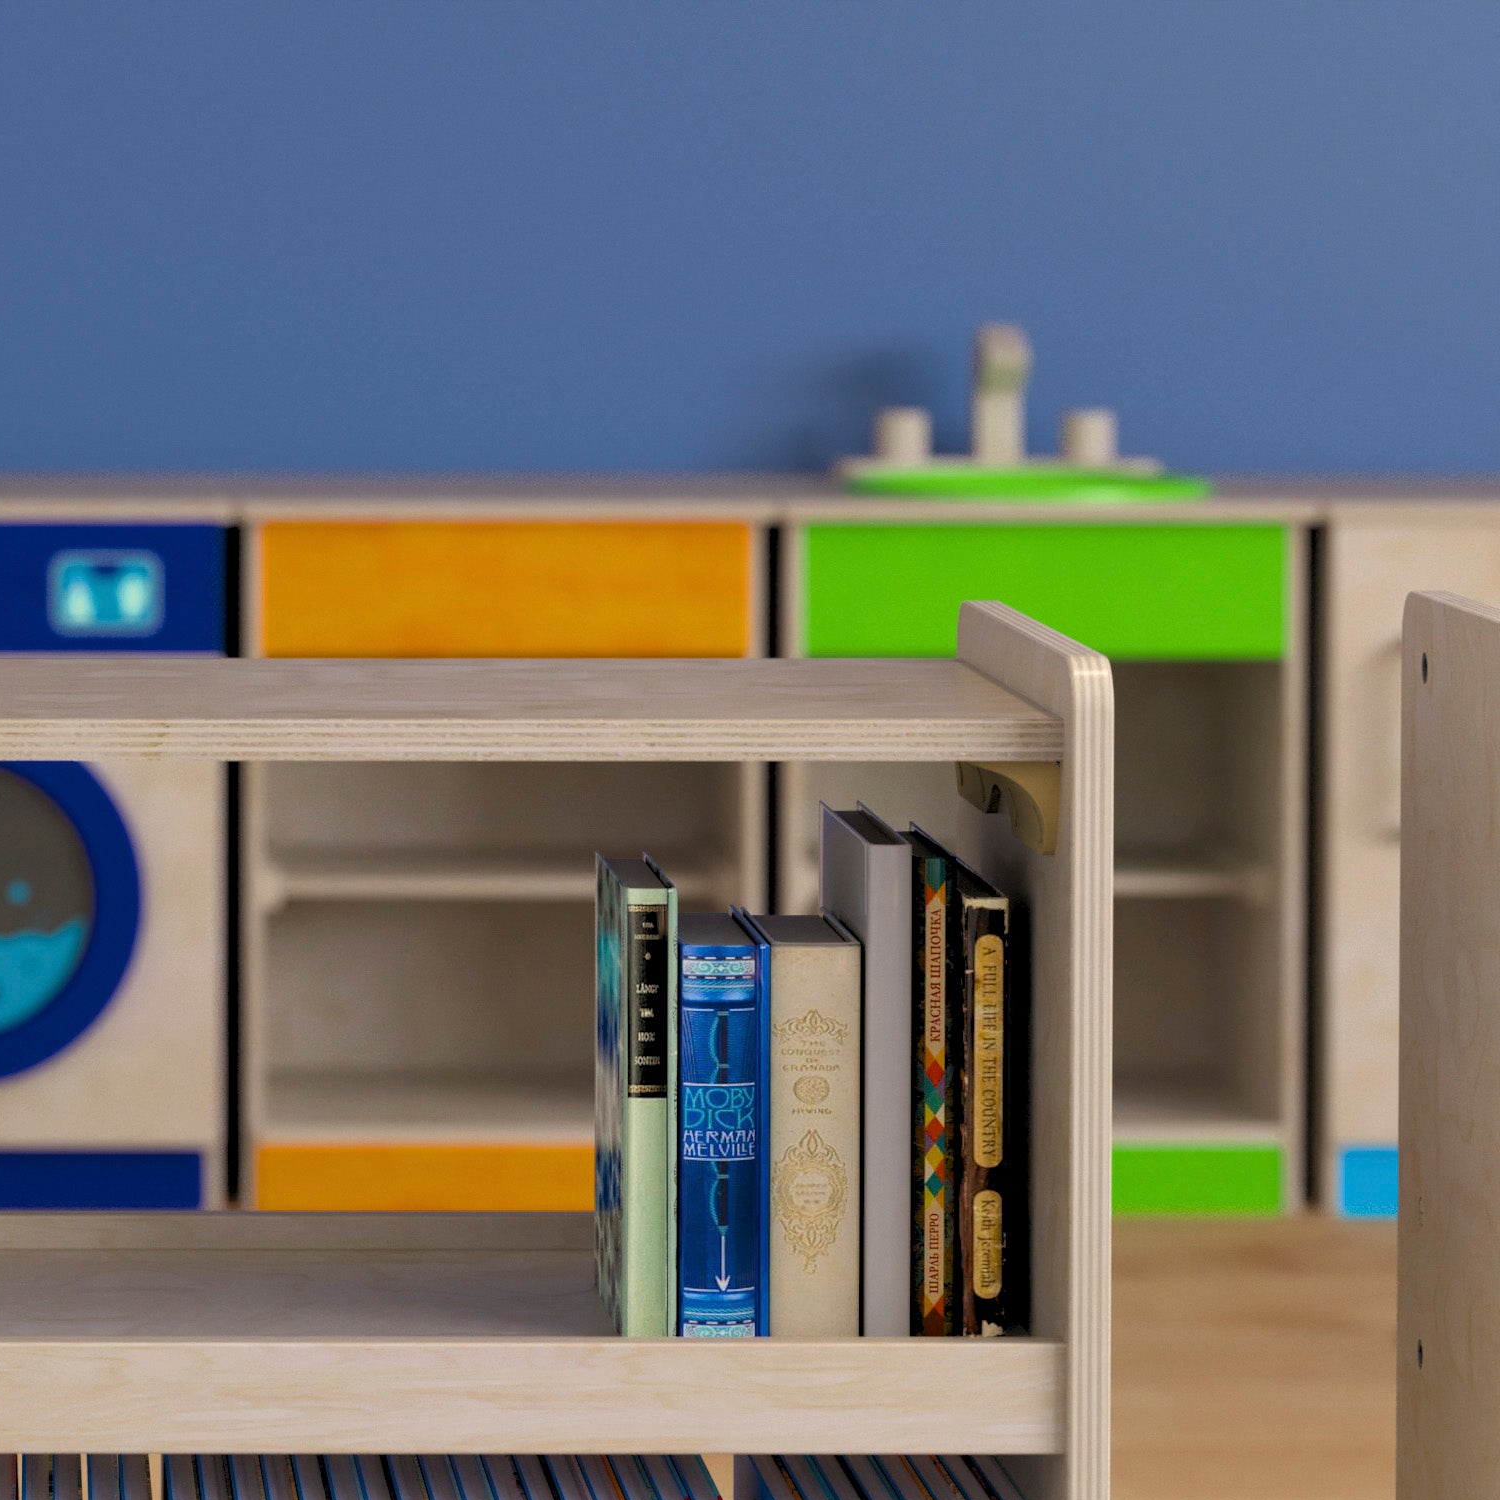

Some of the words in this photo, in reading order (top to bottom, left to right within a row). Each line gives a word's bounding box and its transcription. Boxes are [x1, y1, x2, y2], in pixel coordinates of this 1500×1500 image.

[929, 909, 942, 979] ШАПОЧКА
[982, 946, 998, 957] A
[982, 964, 998, 998] FULL
[929, 982, 942, 1042] КРАСНАЯ
[982, 1003, 998, 1031] LIFE
[982, 1037, 998, 1050] IN
[982, 1057, 998, 1083] THE
[684, 1087, 755, 1109] MOBY
[684, 1108, 755, 1129] DICK
[982, 1089, 998, 1158] COUNTRY
[683, 1129, 756, 1143] HERMAN
[683, 1142, 756, 1157] MELVILLE
[981, 1199, 995, 1231] Keith
[928, 1212, 941, 1250] ПЕРРО
[928, 1253, 941, 1294] ШАРЛЬ
[977, 1235, 994, 1289] Jeremiah
